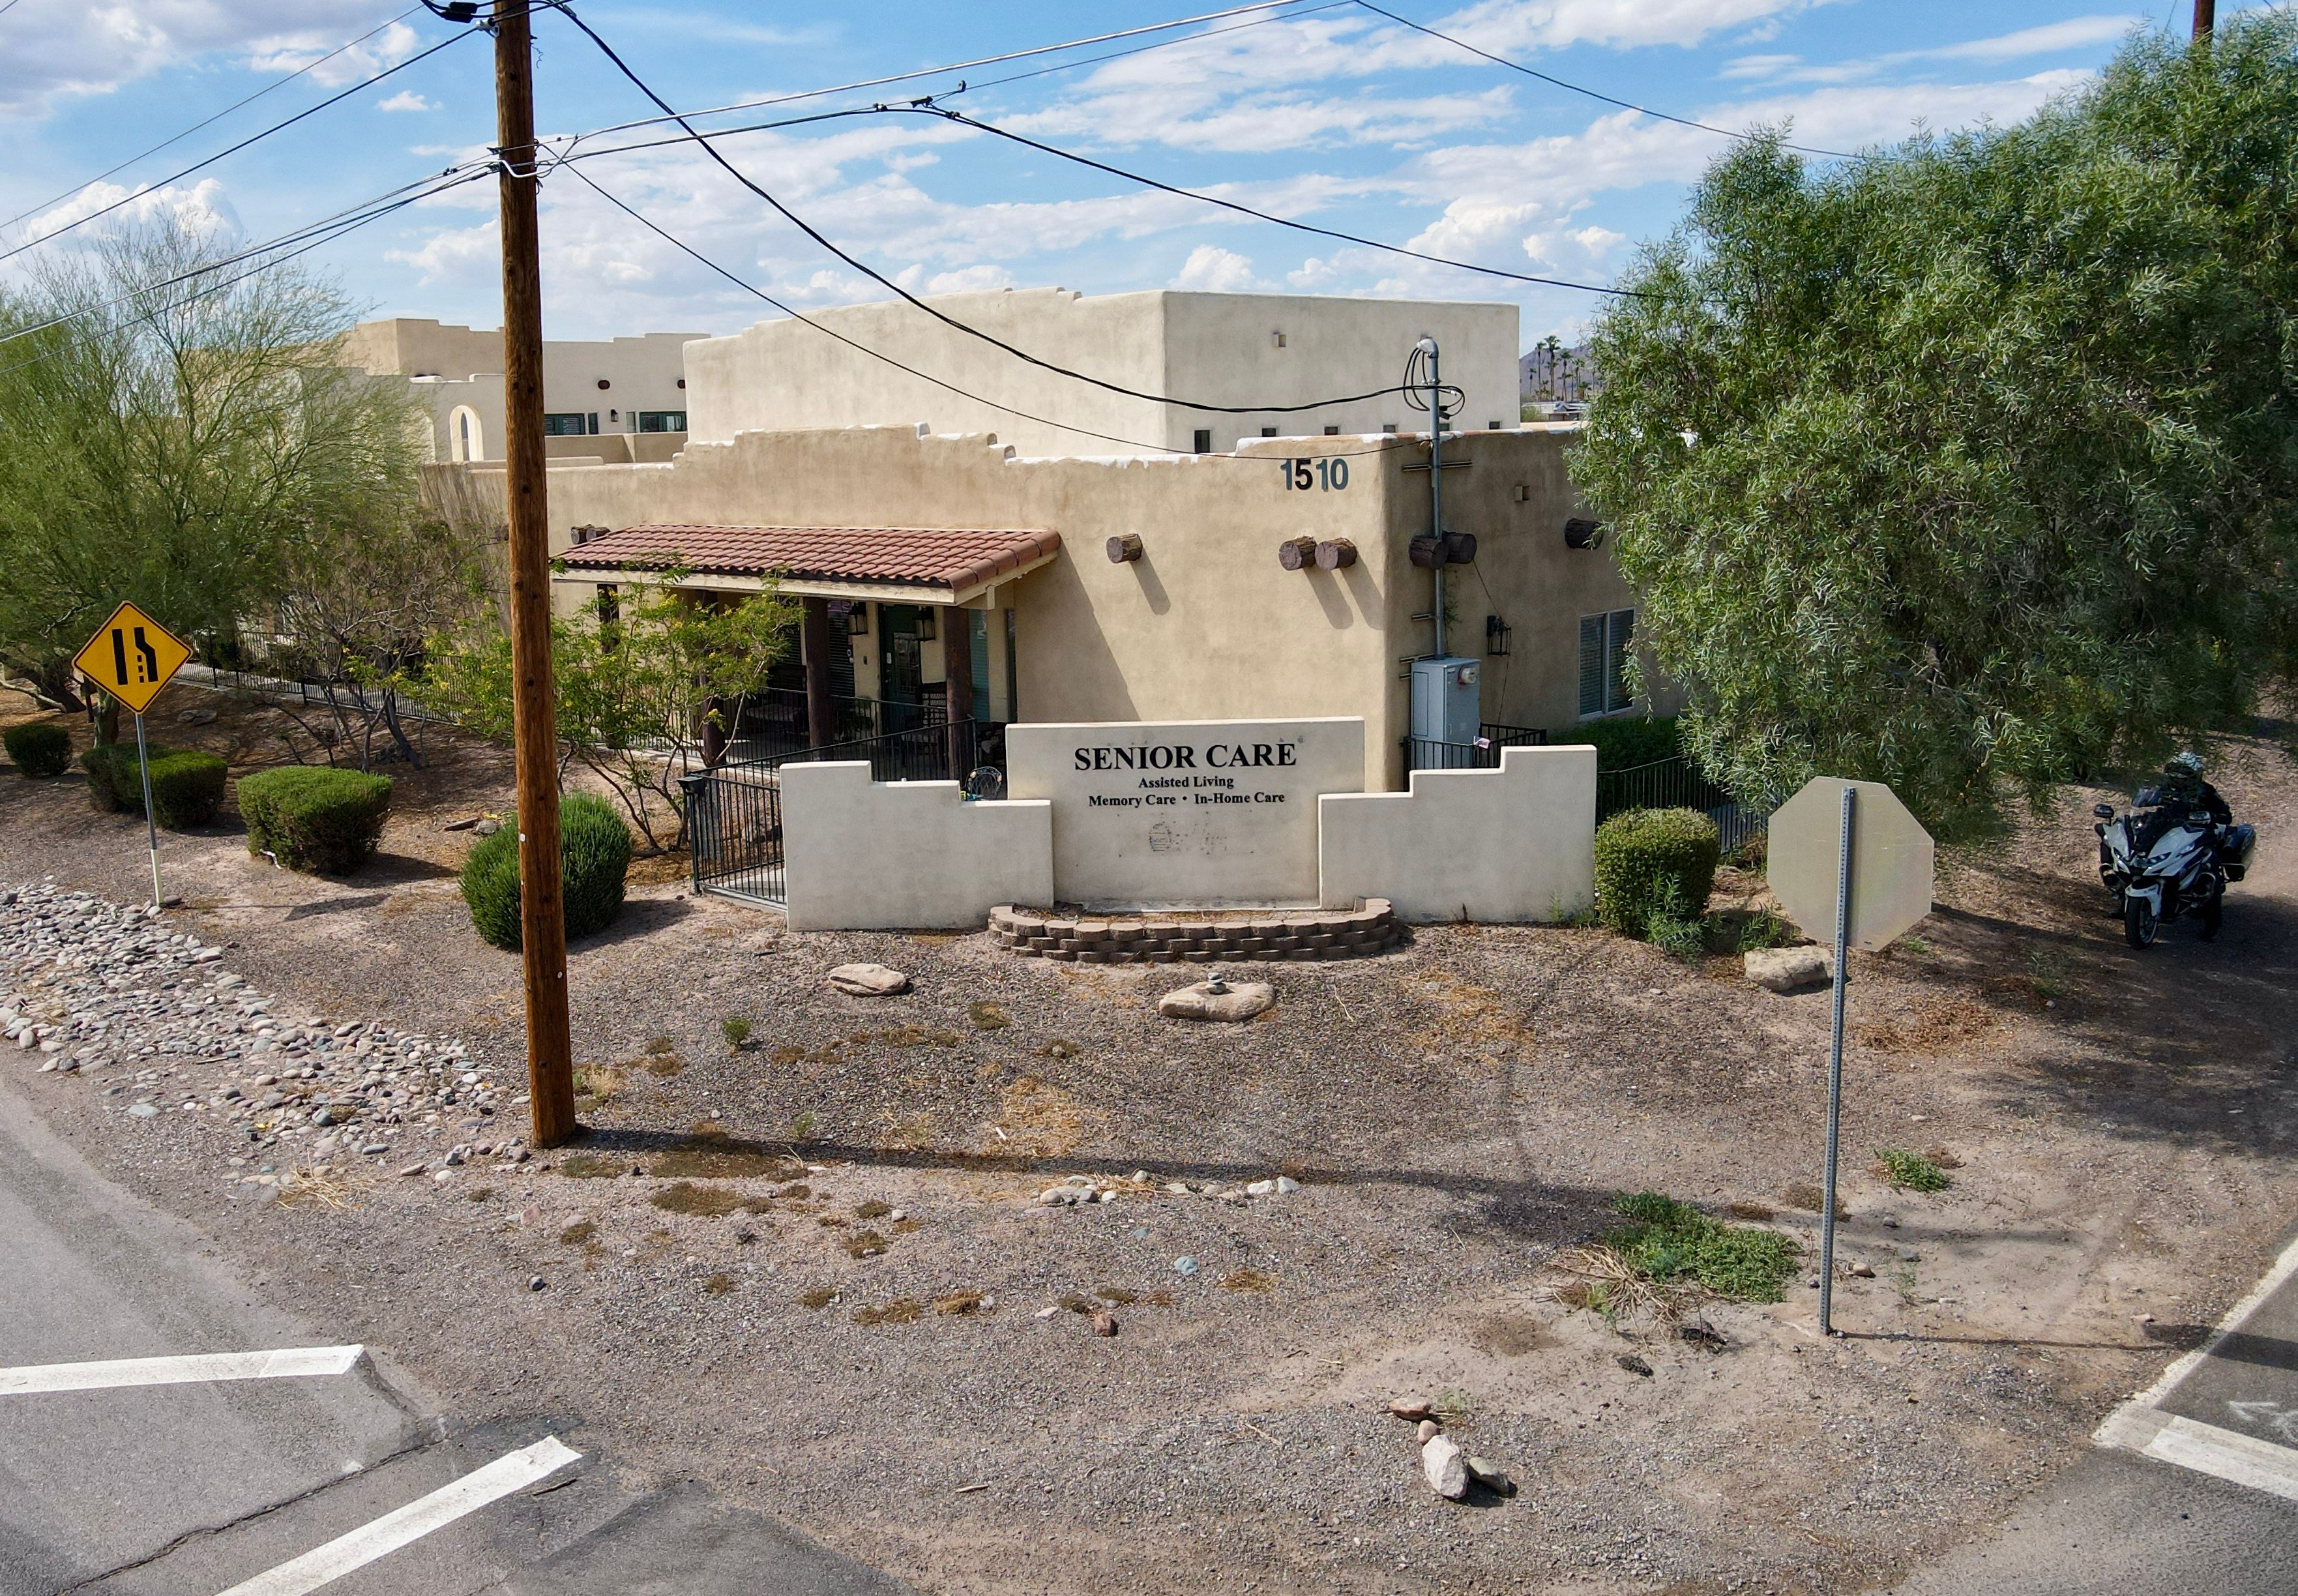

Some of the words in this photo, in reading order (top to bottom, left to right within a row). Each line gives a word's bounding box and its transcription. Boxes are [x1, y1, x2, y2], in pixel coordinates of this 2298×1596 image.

[1280, 458, 1349, 491] 1510
[1074, 745, 1198, 771] SENIOR
[1205, 743, 1297, 768] CARE
[1138, 776, 1190, 789] Assisted
[1193, 775, 1235, 790] Living
[1089, 795, 1142, 808] Memory
[1145, 794, 1176, 806] Care
[1194, 792, 1251, 805] In-Home
[1254, 791, 1285, 803] Care
